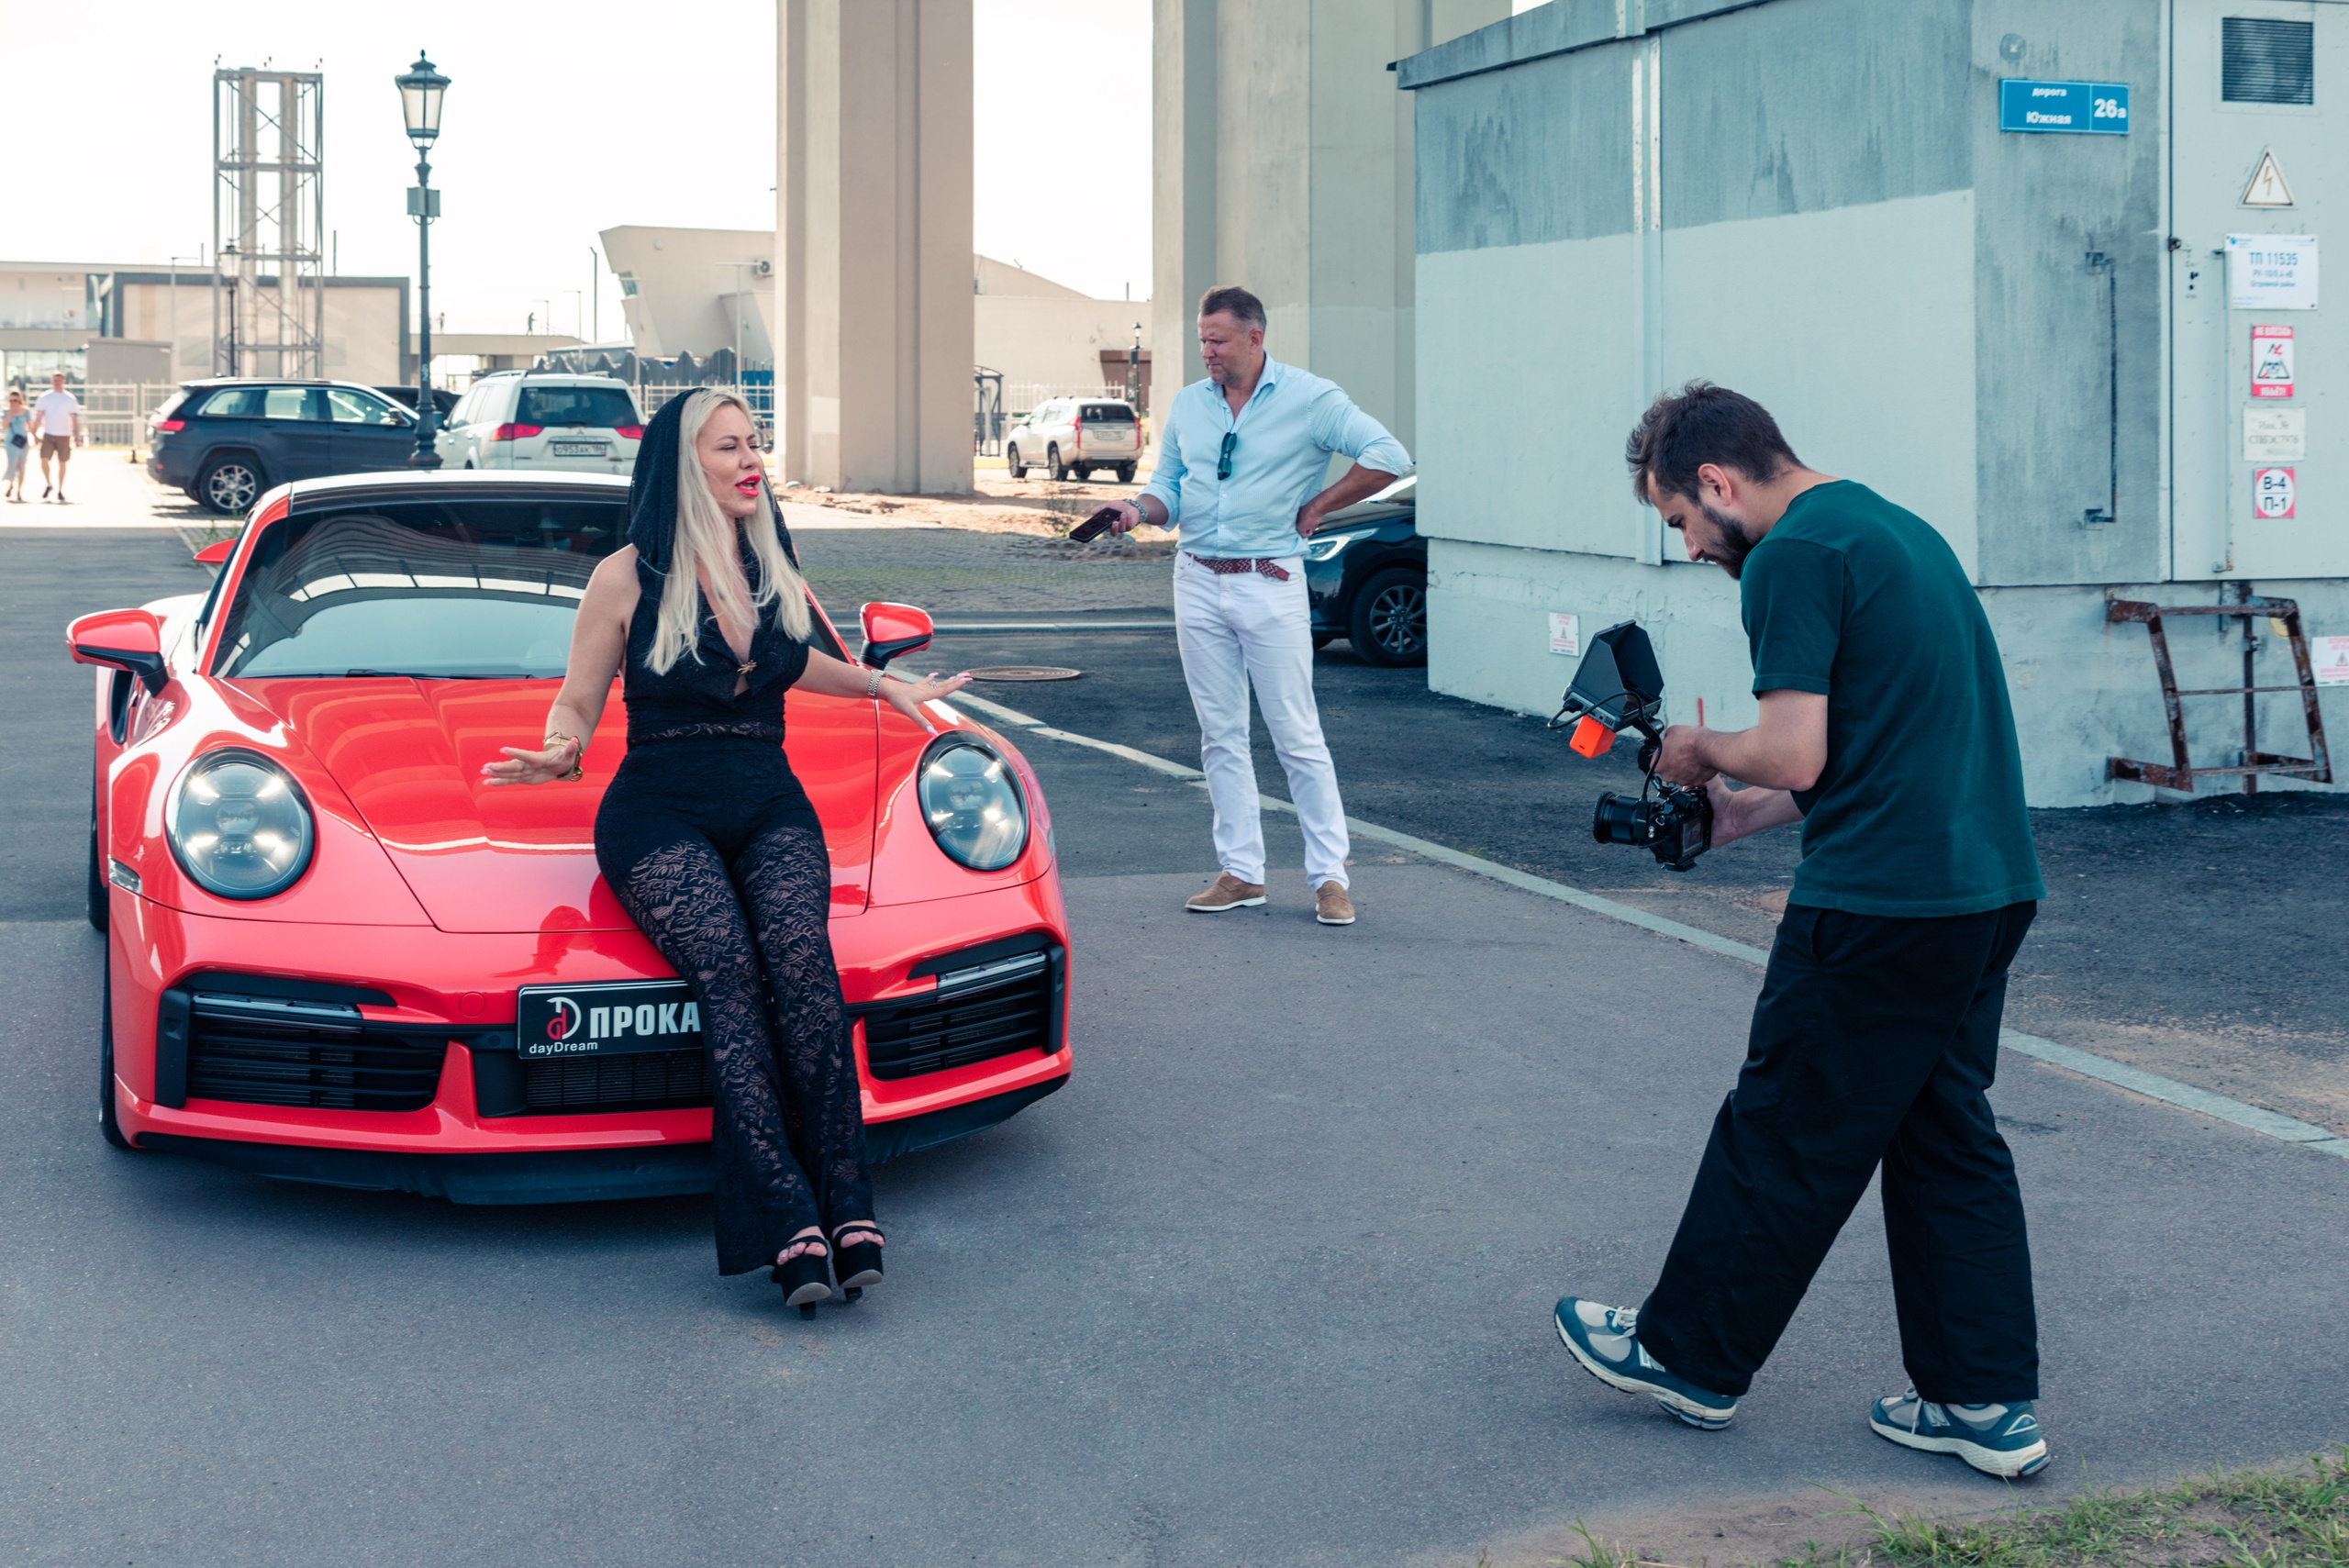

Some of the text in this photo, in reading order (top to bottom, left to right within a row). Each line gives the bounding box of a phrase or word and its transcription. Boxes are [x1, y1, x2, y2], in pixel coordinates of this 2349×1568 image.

[2032, 87, 2067, 98] дорога
[2094, 98, 2127, 118] 26а
[2026, 111, 2072, 124] Южная
[2249, 252, 2299, 266] ТП 11535
[2264, 476, 2287, 490] В-4
[2264, 496, 2287, 511] П-1
[589, 1001, 701, 1039] ПРОКА
[529, 1040, 599, 1056] dayDream
